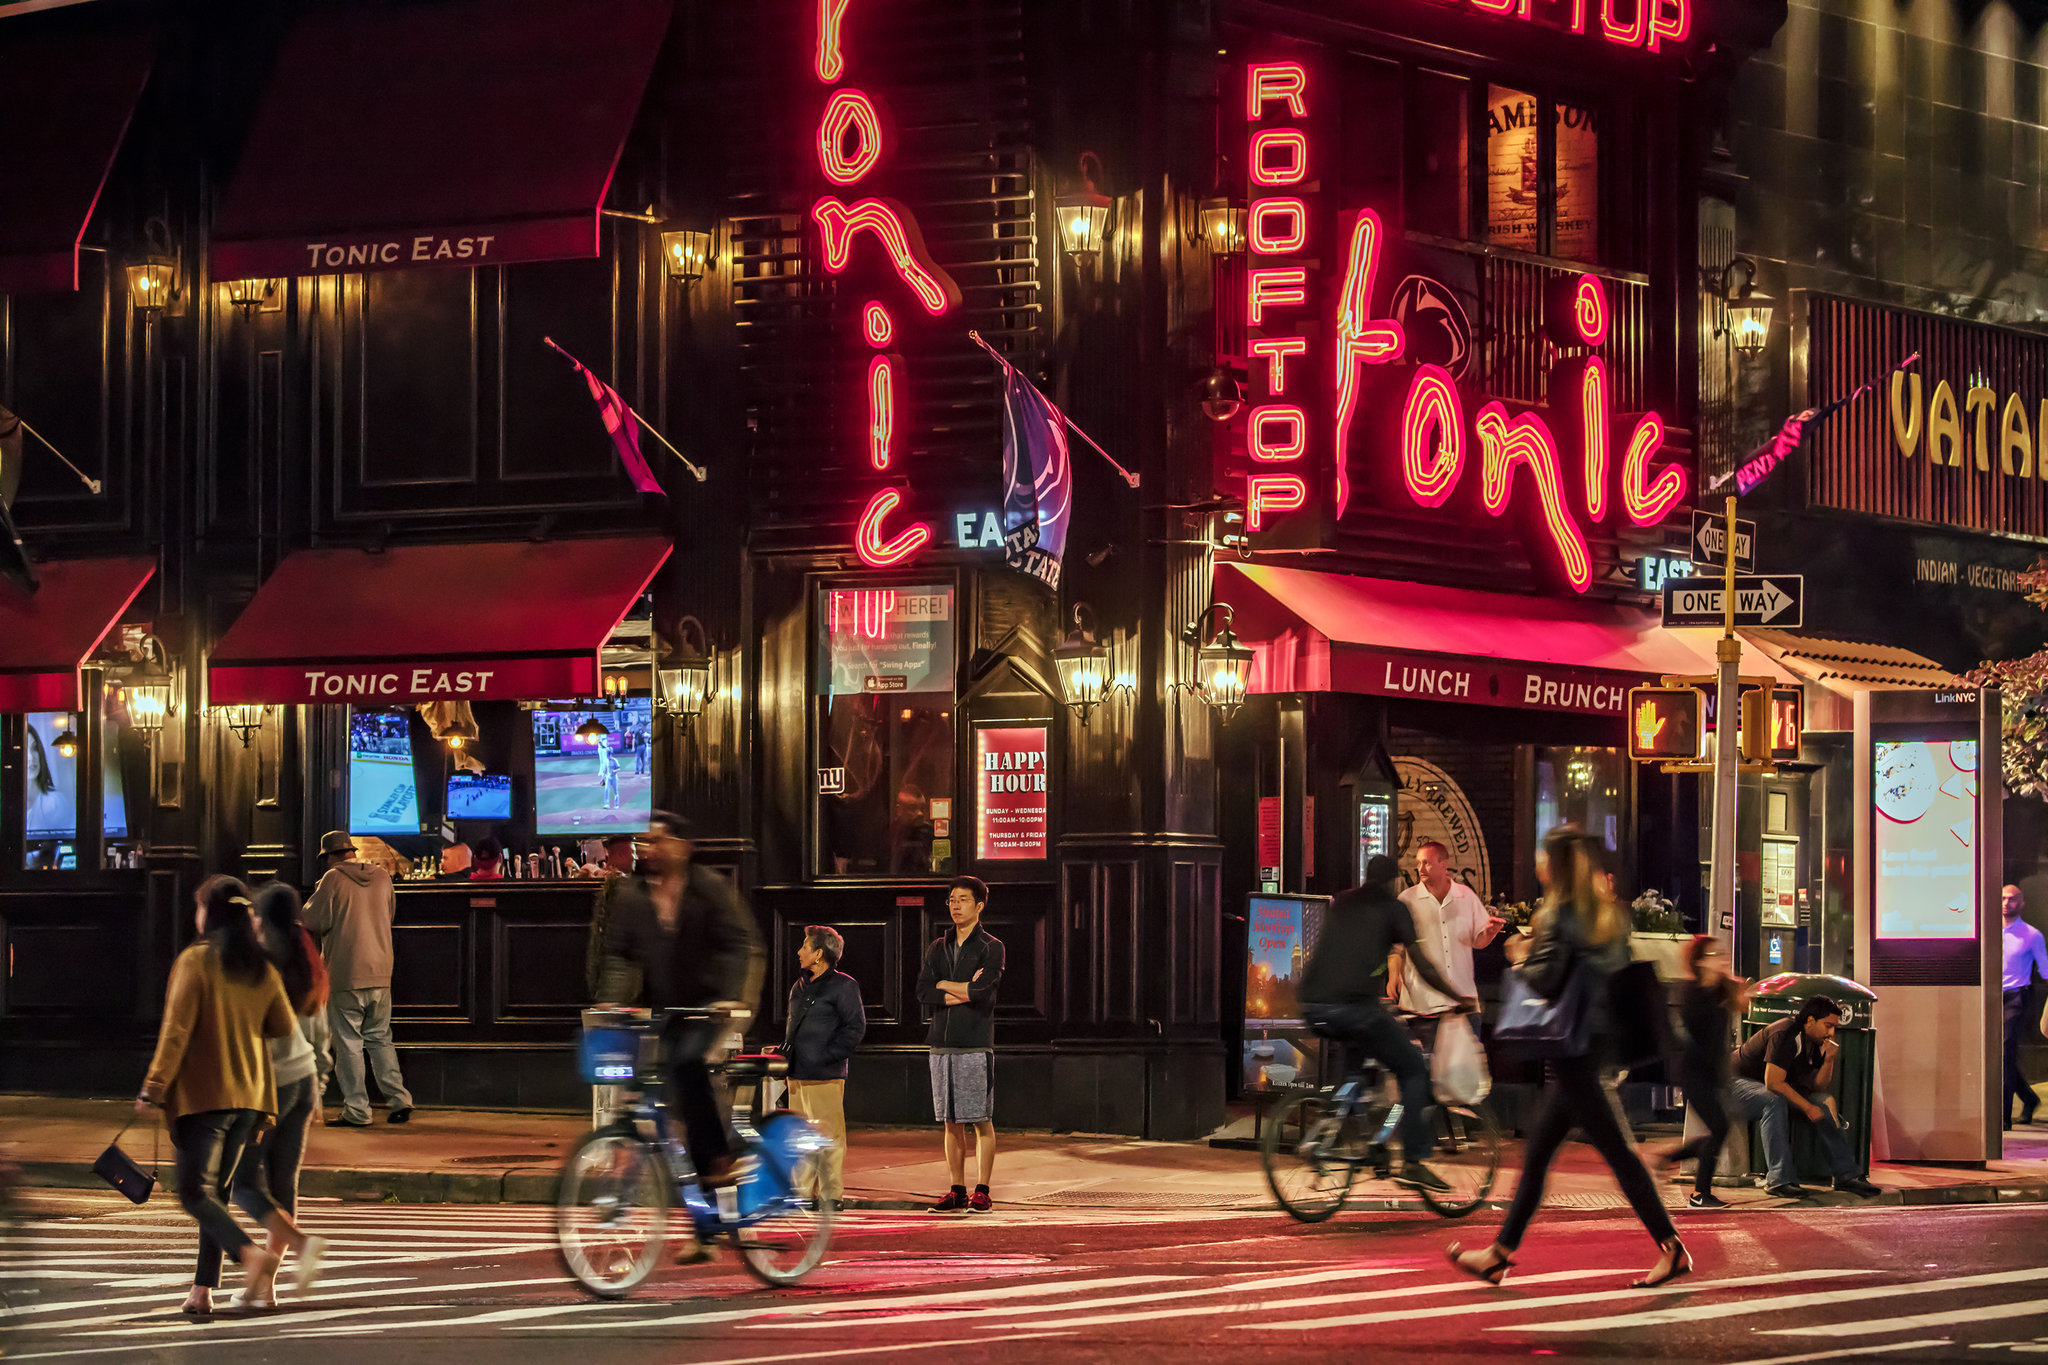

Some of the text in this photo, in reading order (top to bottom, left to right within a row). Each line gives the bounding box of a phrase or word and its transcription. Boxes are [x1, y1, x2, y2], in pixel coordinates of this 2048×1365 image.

[306, 235, 495, 268] TONIC EAST
[1246, 61, 1307, 532] ROOFTOP
[1705, 529, 1747, 555] ONE AY
[1917, 558, 1958, 584] INDIAN
[896, 597, 942, 616] HERE!
[1683, 592, 1780, 611] ONE WAY
[305, 668, 494, 697] TONIC EAST
[1384, 661, 1625, 711] LUNCH BRUNCH
[1935, 692, 1976, 704] LinkNYC
[990, 773, 1047, 793] HOUR
[986, 807, 1009, 815] SUNDAY
[1256, 905, 1290, 919] Heated
[1252, 919, 1295, 938] Rooftop
[1258, 936, 1286, 952] Open
